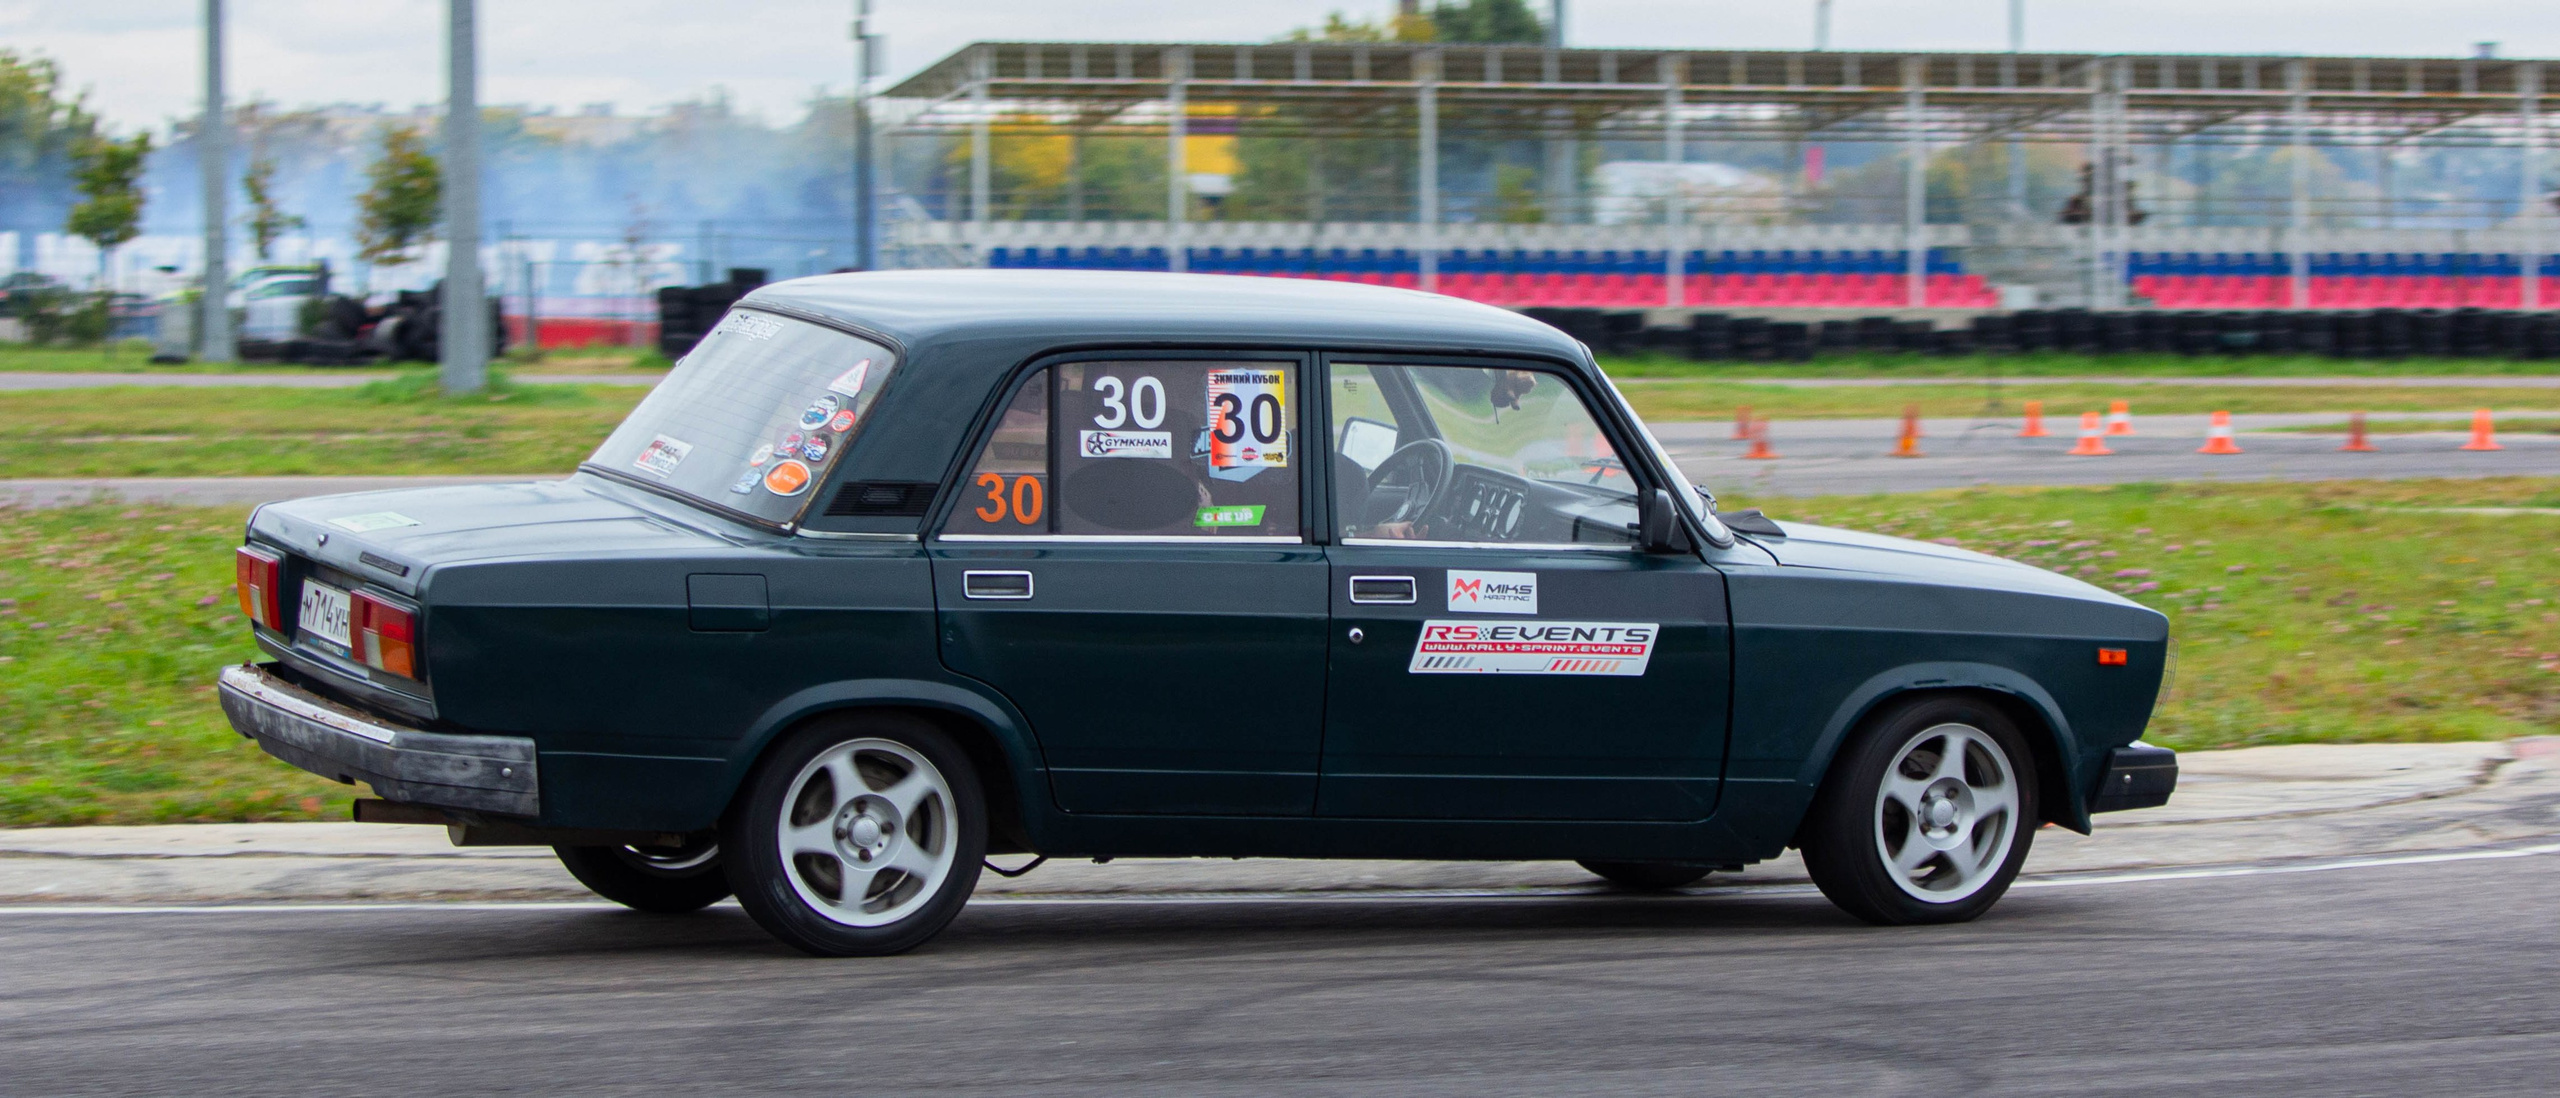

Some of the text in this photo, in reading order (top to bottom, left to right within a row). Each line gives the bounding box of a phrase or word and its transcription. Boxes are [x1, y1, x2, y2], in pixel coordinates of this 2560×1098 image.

[1213, 372, 1280, 385] ЗИМНИЙ КУБОК
[1093, 376, 1167, 430] 30
[1212, 393, 1282, 445] 30
[1104, 438, 1168, 448] GYMKHANA
[975, 472, 1043, 526] 30
[1485, 583, 1533, 595] MIKS
[1483, 594, 1531, 602] KARTING
[1424, 625, 1651, 642] RS EVENTS
